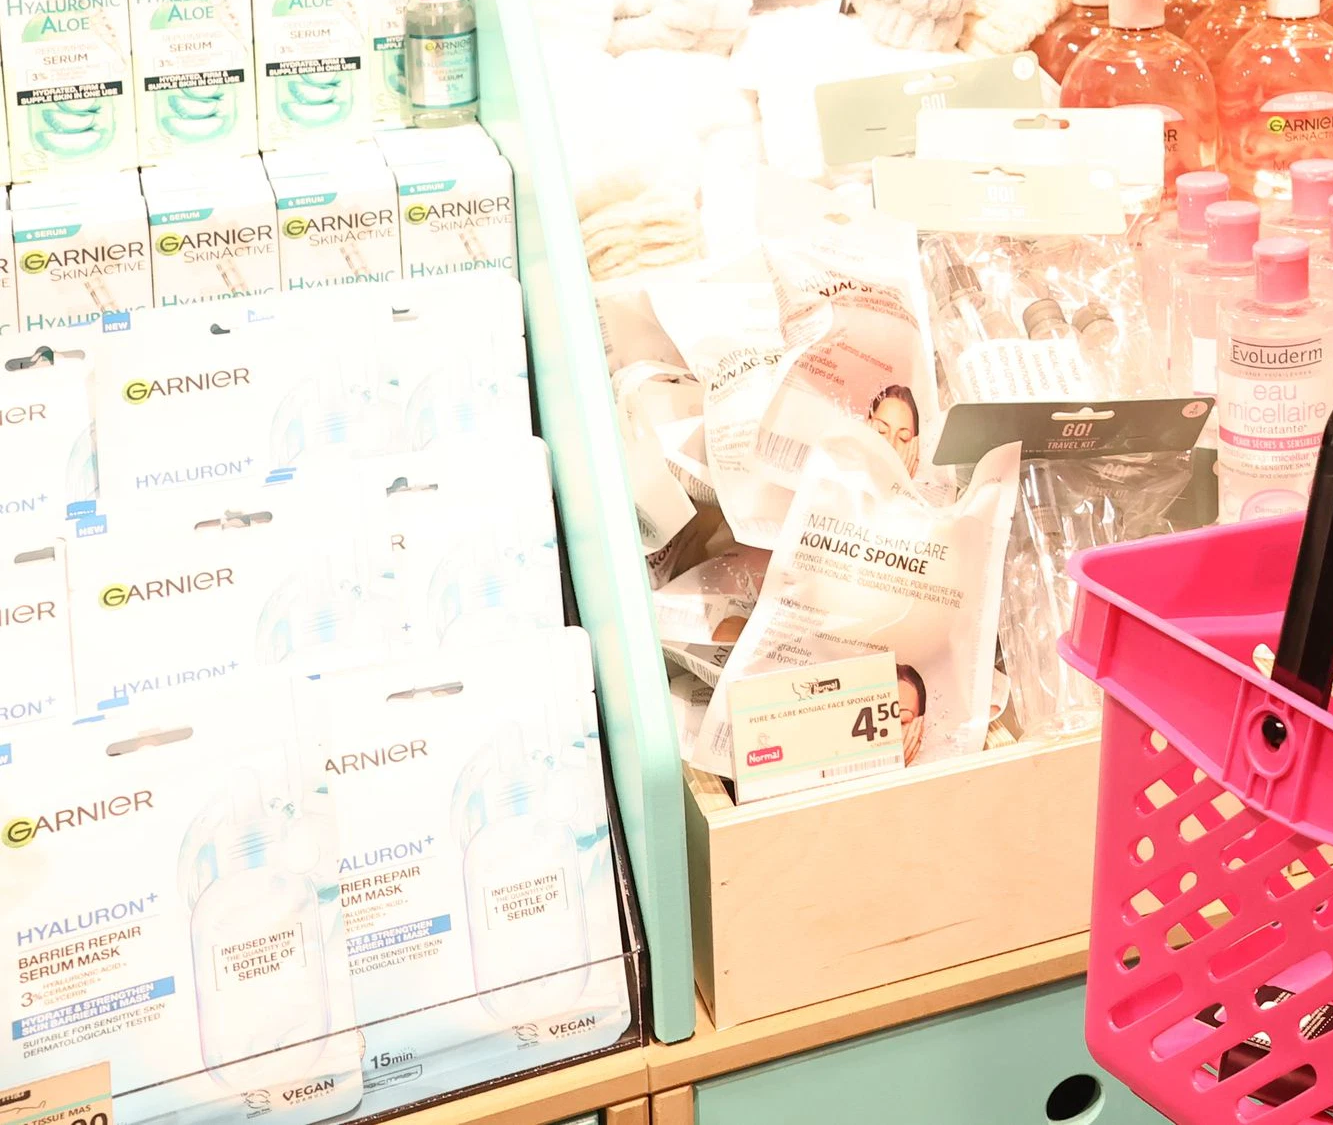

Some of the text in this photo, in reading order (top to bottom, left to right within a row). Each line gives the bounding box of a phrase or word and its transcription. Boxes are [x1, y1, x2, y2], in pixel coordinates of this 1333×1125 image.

[41, 16, 90, 34] ALOE
[168, 4, 214, 22] ALOE
[405, 196, 510, 223] GARNIER
[285, 208, 394, 237] GARNIER
[159, 224, 273, 253] GARNIER
[24, 241, 145, 271] GARNIER
[104, 320, 128, 332] NEW
[1232, 345, 1322, 365] Evoluderm
[125, 366, 251, 402] GARNIER
[1253, 384, 1297, 400] eau
[1228, 401, 1326, 423] micellaire
[1062, 423, 1093, 437] GO!
[78, 522, 106, 537] NEW
[808, 513, 948, 561] NATURAL SKIN CARE
[800, 531, 928, 575] KONJAC SPONGE
[749, 713, 768, 723] PURE
[779, 709, 797, 720] CARE
[798, 705, 826, 715] KONJAC
[828, 701, 845, 710] FACE
[846, 695, 875, 705] SPONGE
[876, 691, 892, 701] NAT
[851, 701, 900, 742] 4.50
[749, 749, 780, 763] Normal
[374, 865, 421, 885] REPAIR
[368, 883, 402, 901] MASK
[18, 926, 142, 970] BARRIER REPAIR
[220, 929, 295, 957] INFUSED WITH
[19, 945, 121, 984] SERUM MASK
[549, 1015, 596, 1036] VEGAN
[282, 1078, 335, 1102] VEGAN
